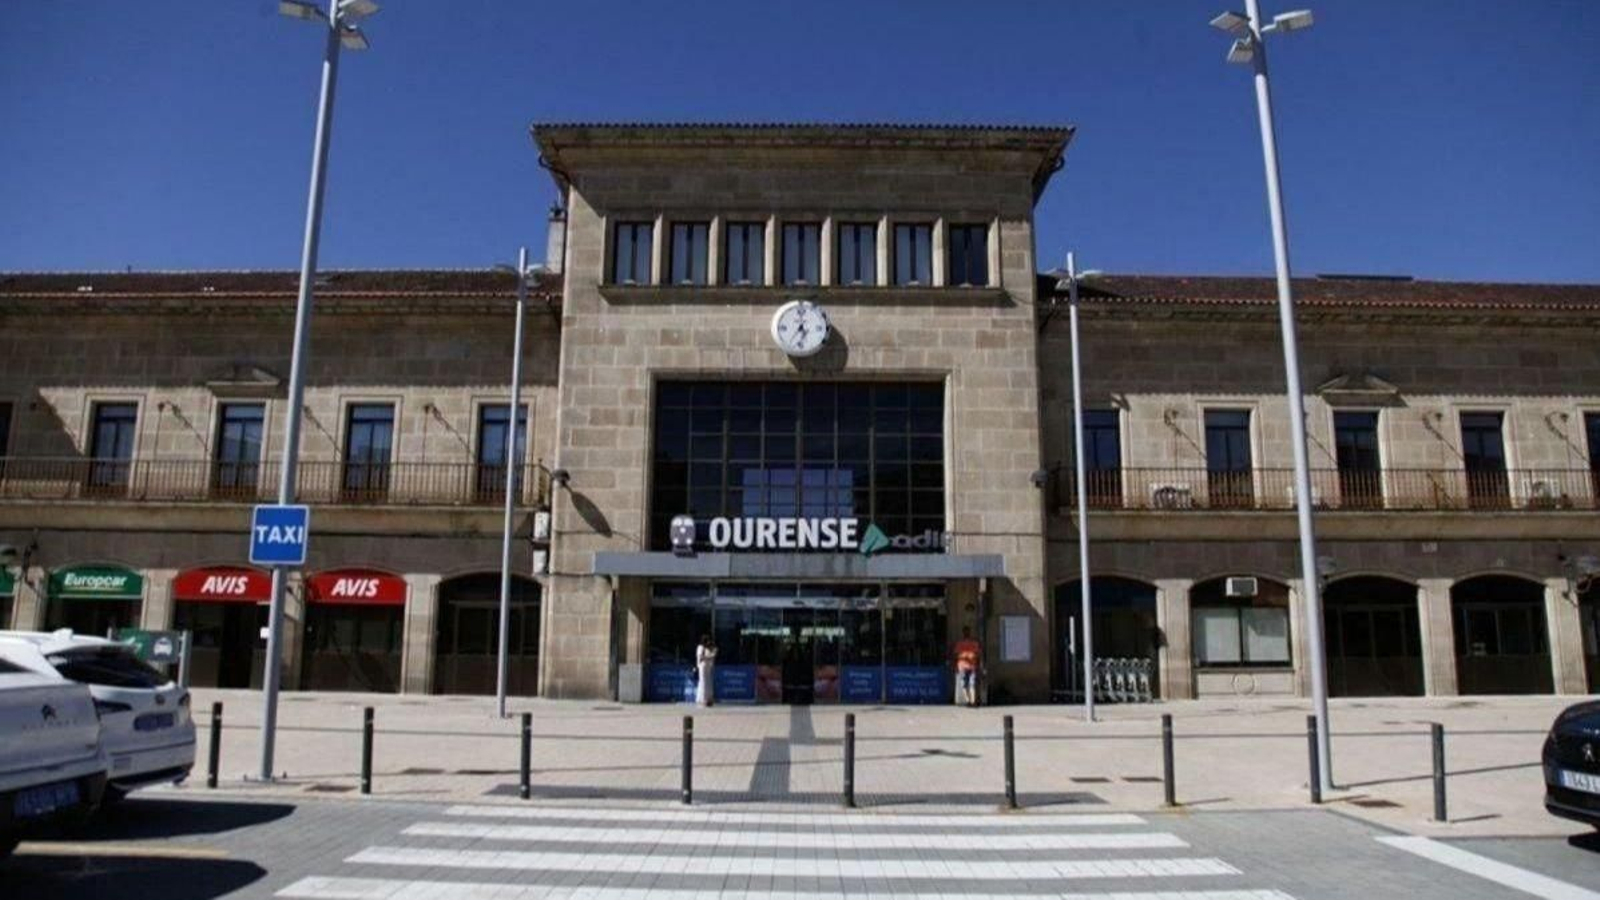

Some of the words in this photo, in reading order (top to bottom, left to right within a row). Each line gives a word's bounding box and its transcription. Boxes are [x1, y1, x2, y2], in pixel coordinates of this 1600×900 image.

[256, 525, 304, 544] TAXI
[708, 516, 858, 548] OURENSE
[64, 573, 127, 588] Europcar
[201, 576, 248, 594] AVIS
[332, 579, 379, 597] AVIS
